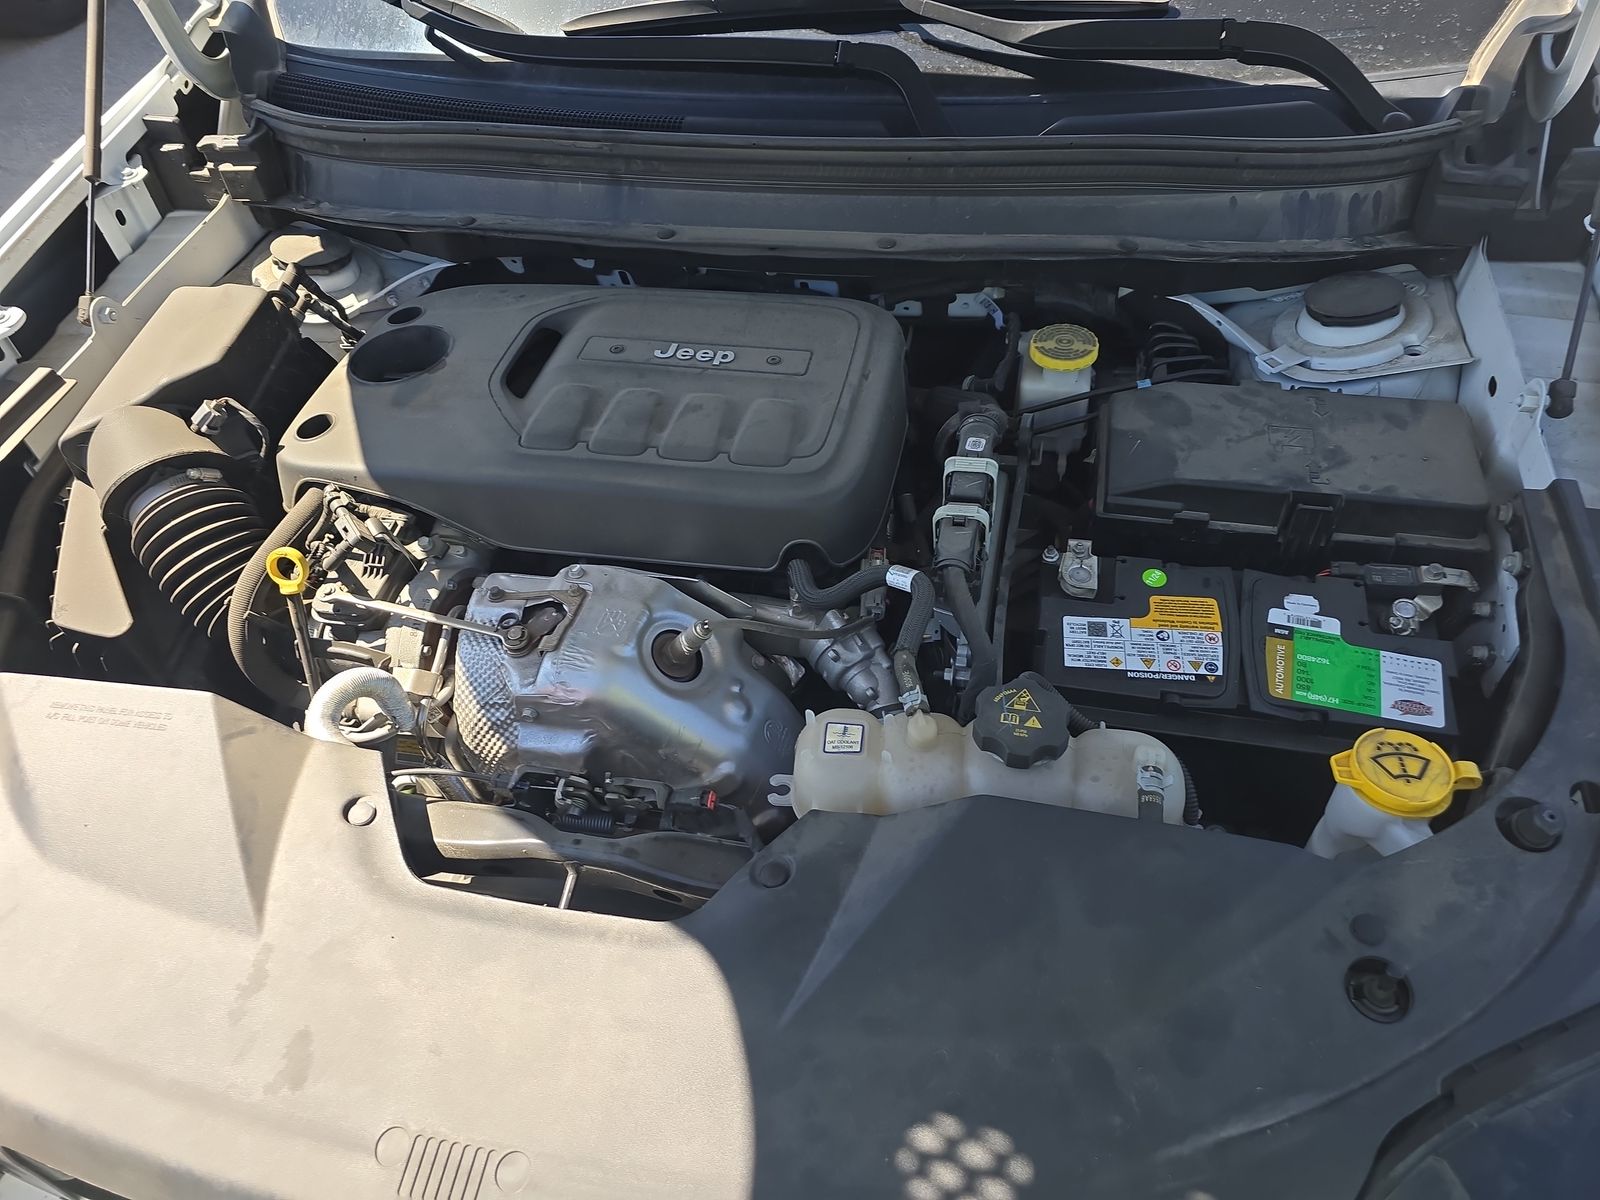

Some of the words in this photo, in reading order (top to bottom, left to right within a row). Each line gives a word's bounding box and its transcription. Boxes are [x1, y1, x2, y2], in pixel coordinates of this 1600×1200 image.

[654, 342, 735, 366] Jeep
[1297, 654, 1330, 664] 1624800
[1128, 672, 1196, 681] DANGER/POISON
[1274, 644, 1286, 695] AUTOMOTIVE
